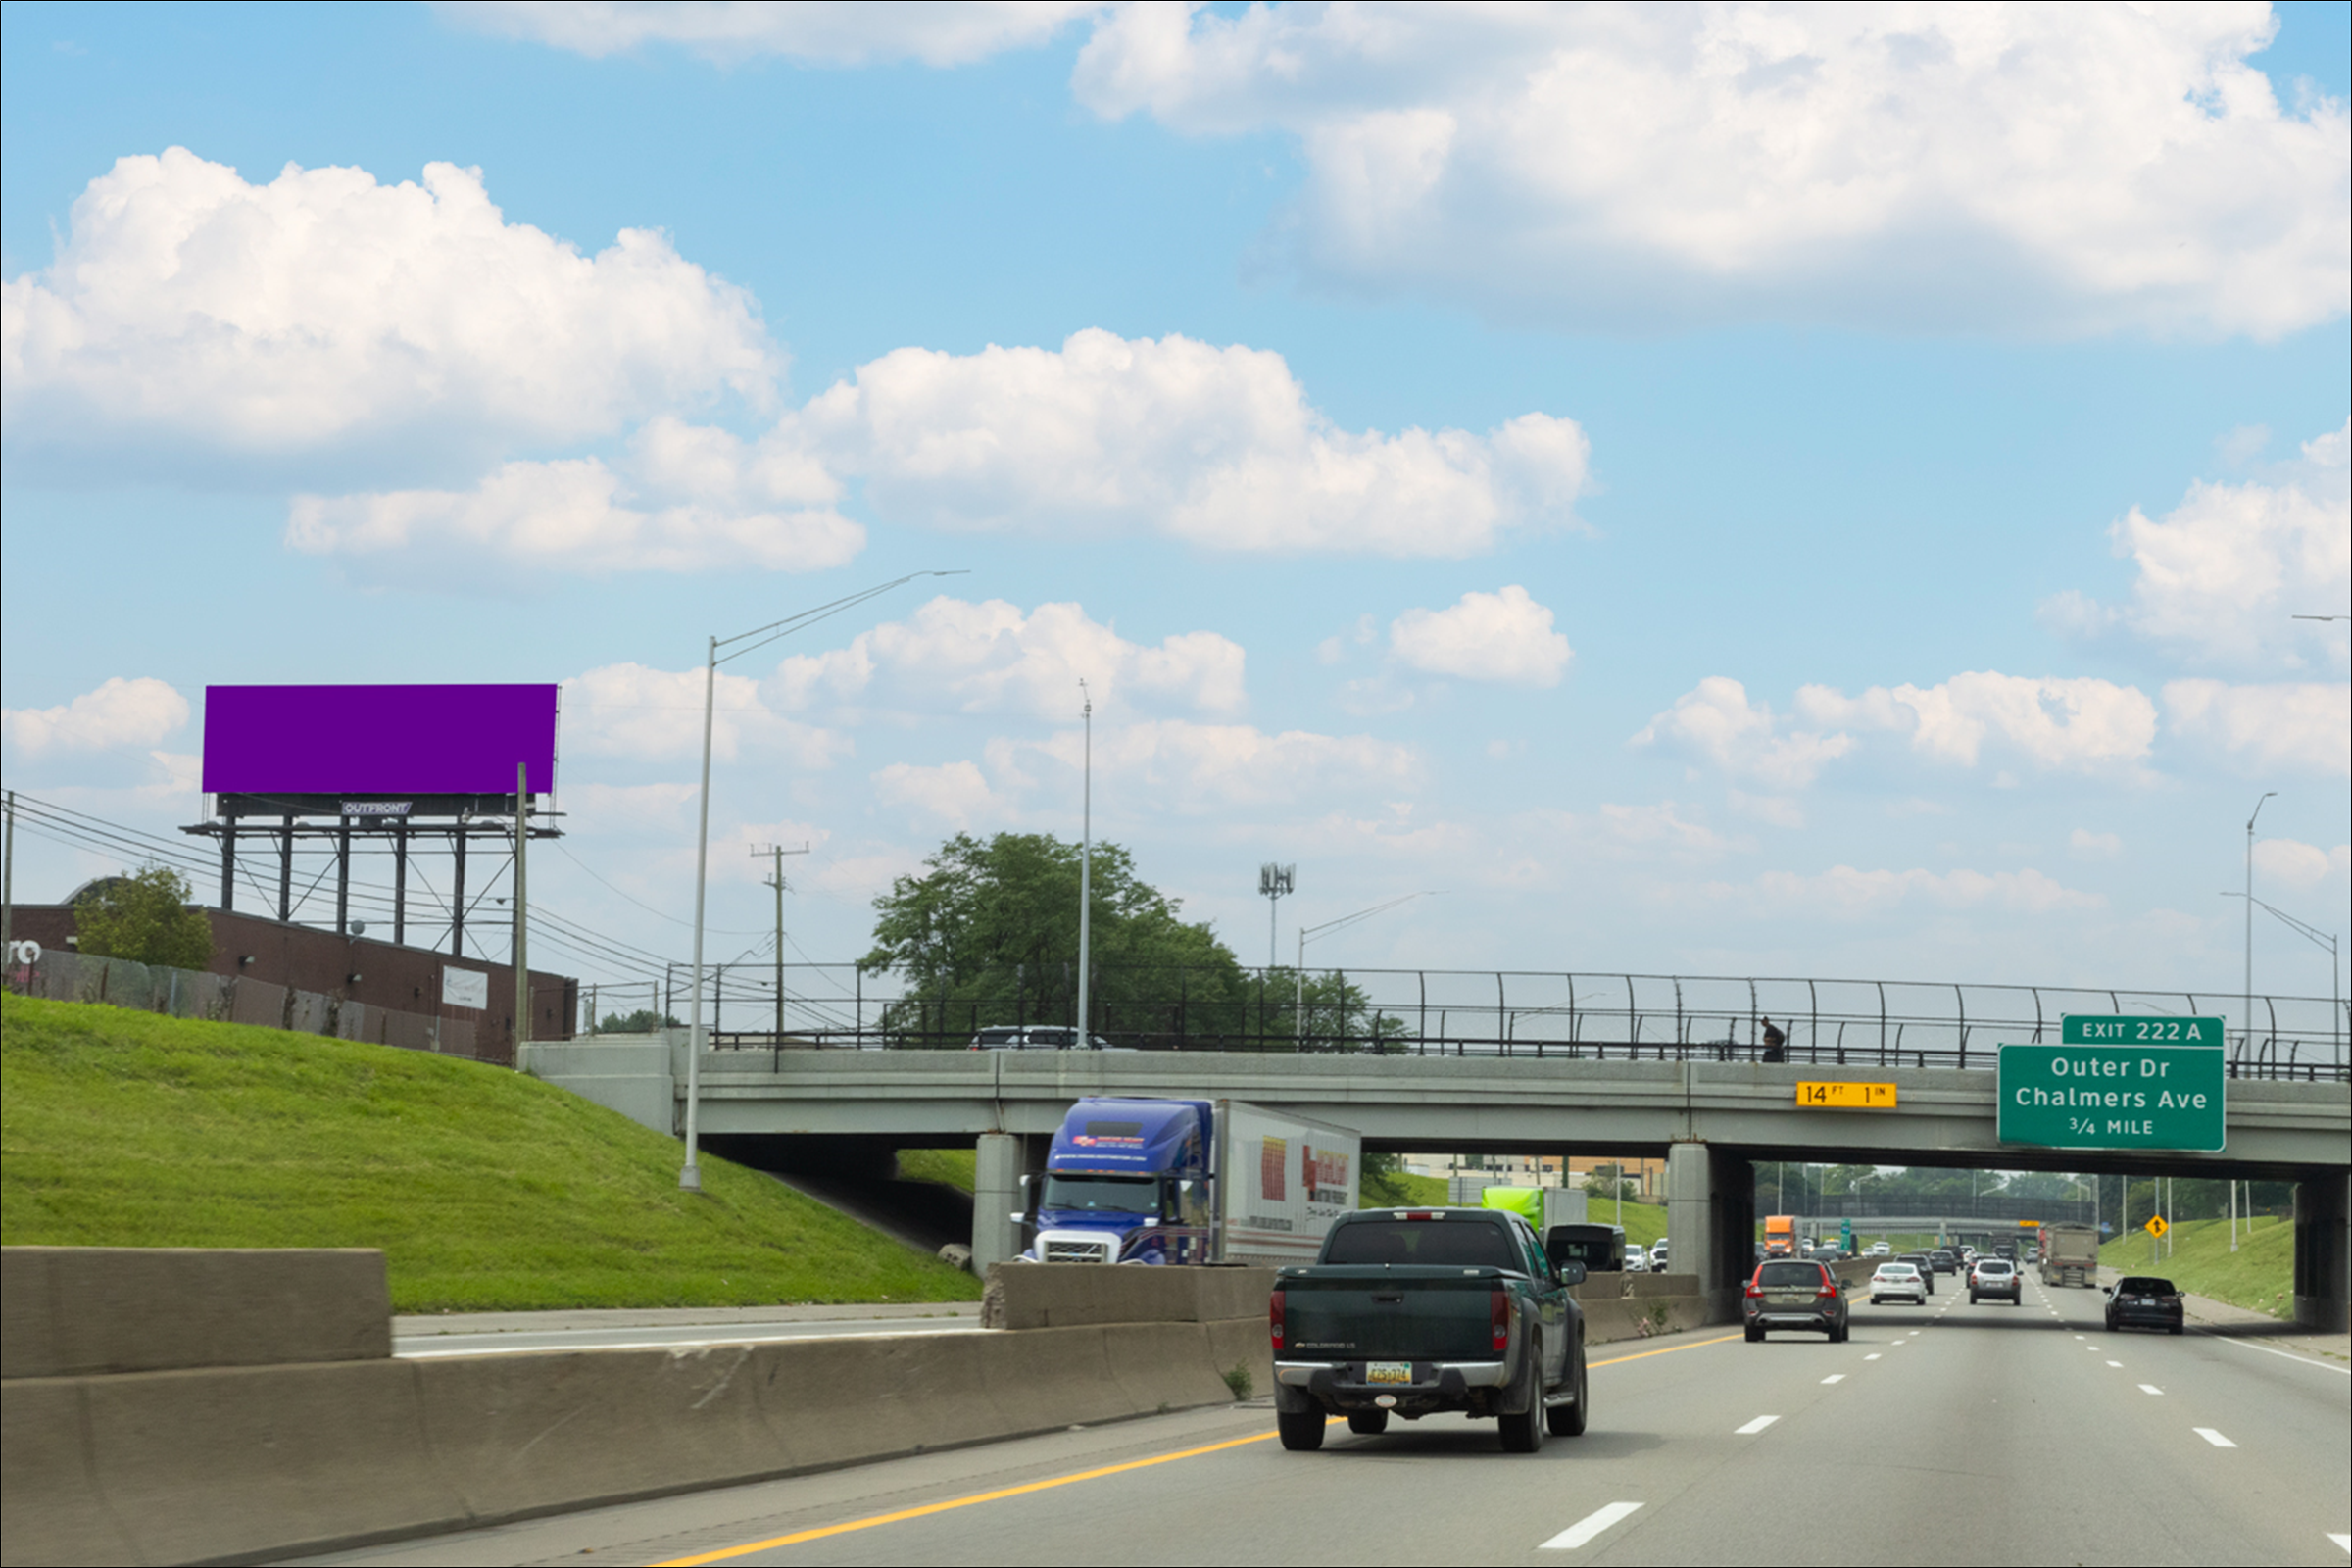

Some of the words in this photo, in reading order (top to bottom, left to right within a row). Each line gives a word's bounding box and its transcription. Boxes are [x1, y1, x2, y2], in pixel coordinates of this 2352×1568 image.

[344, 803, 407, 813] OUTFRONT
[2082, 1023, 2126, 1038] EXIT
[2136, 1022, 2180, 1041] 222
[2185, 1023, 2203, 1041] A
[2051, 1057, 2131, 1077] Outer
[2140, 1058, 2171, 1078] Dr
[1806, 1085, 1827, 1102] 14
[1831, 1085, 1844, 1095] FT
[1865, 1086, 1870, 1103] 1
[1874, 1087, 1886, 1096] IN
[2015, 1087, 2147, 1108] Chalmers
[2157, 1090, 2207, 1109] Ave
[2068, 1117, 2096, 1135] 3/4
[2107, 1120, 2154, 1135] MILE
